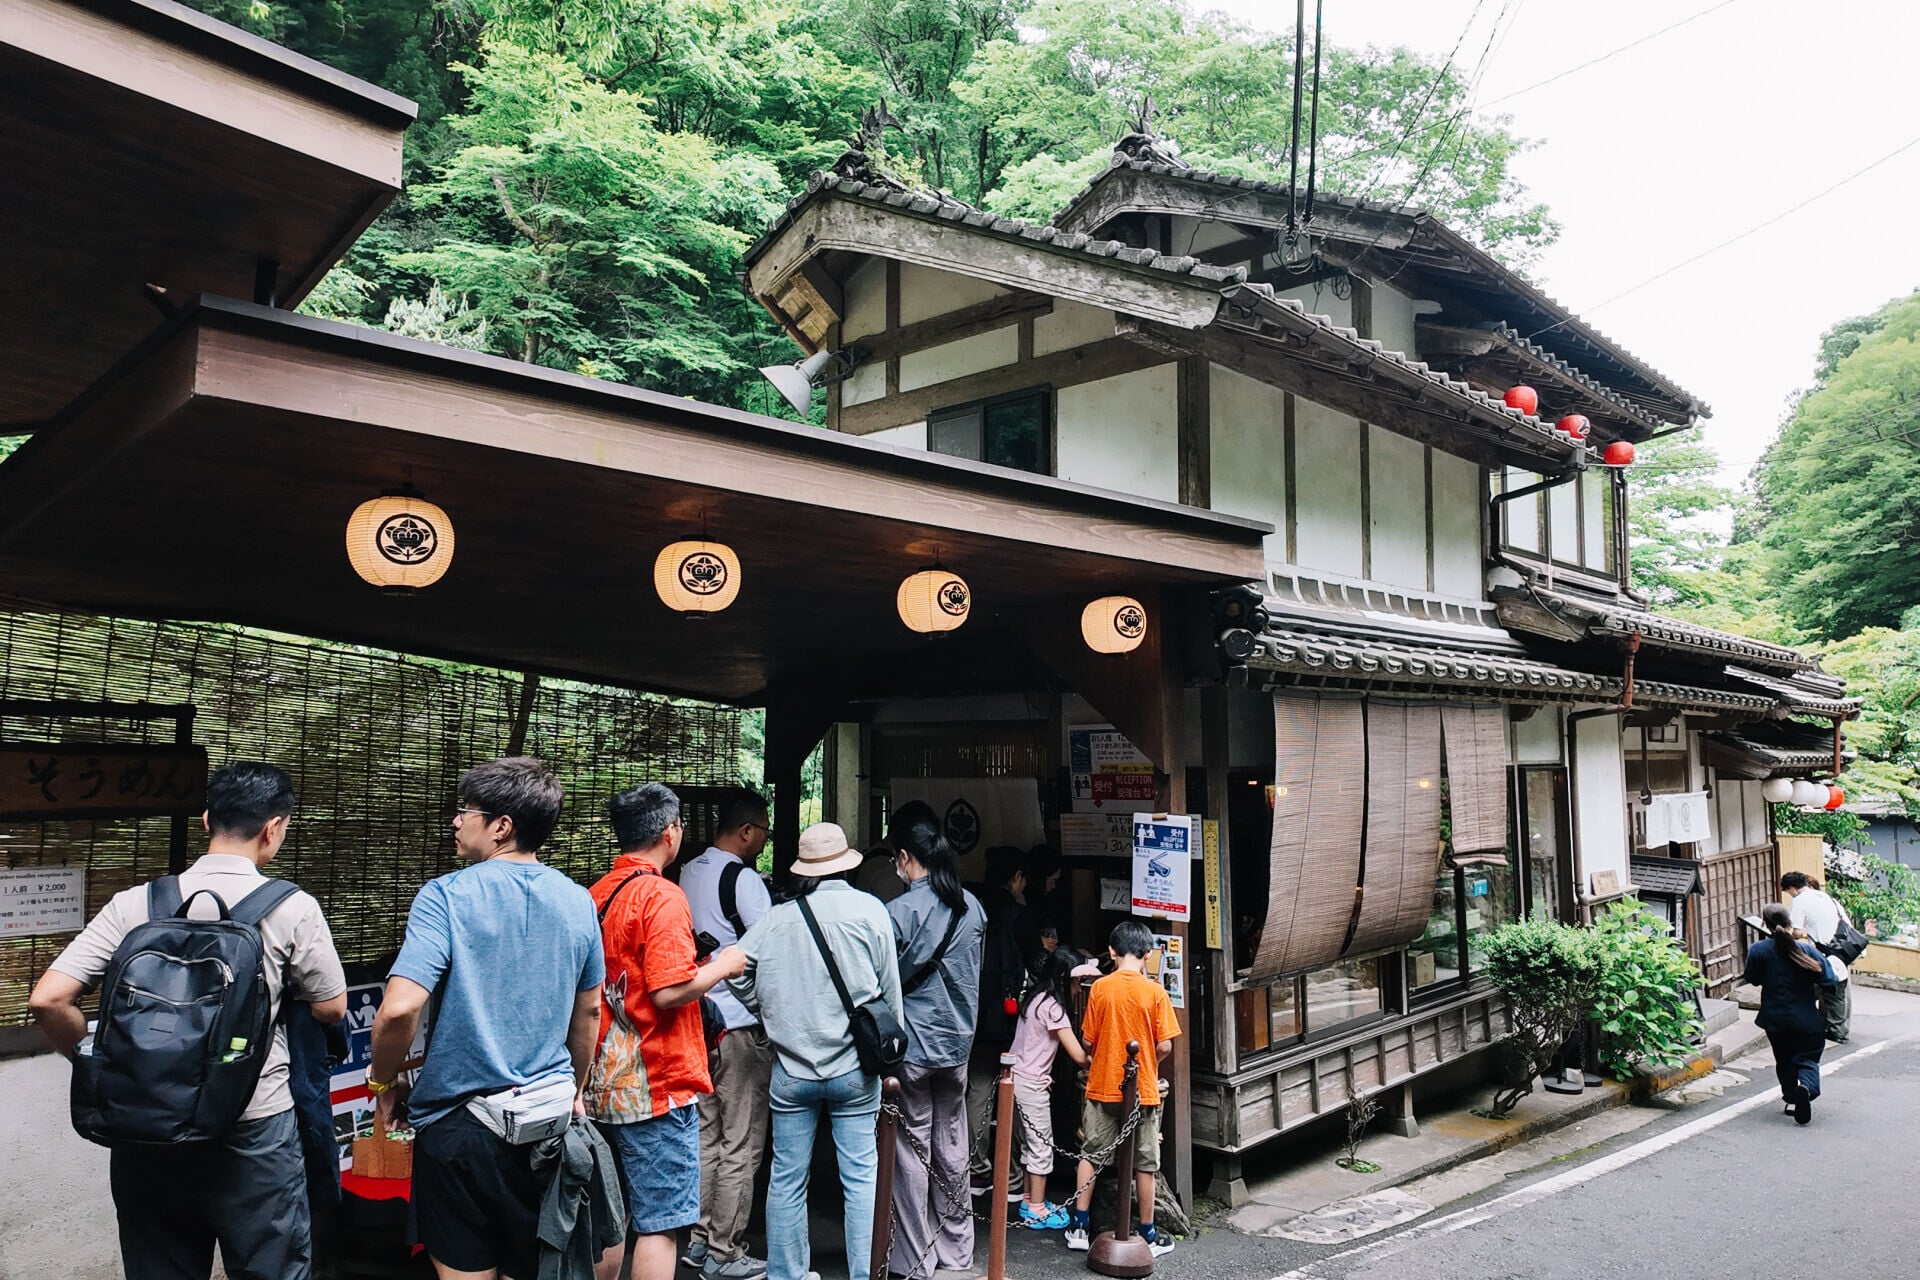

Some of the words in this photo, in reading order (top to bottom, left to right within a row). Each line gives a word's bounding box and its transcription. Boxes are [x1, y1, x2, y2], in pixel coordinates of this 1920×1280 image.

[27, 755, 195, 802] そうめん
[1115, 774, 1152, 785] RECEPTION
[1094, 780, 1113, 793] 受付
[1170, 828, 1185, 838] 受付
